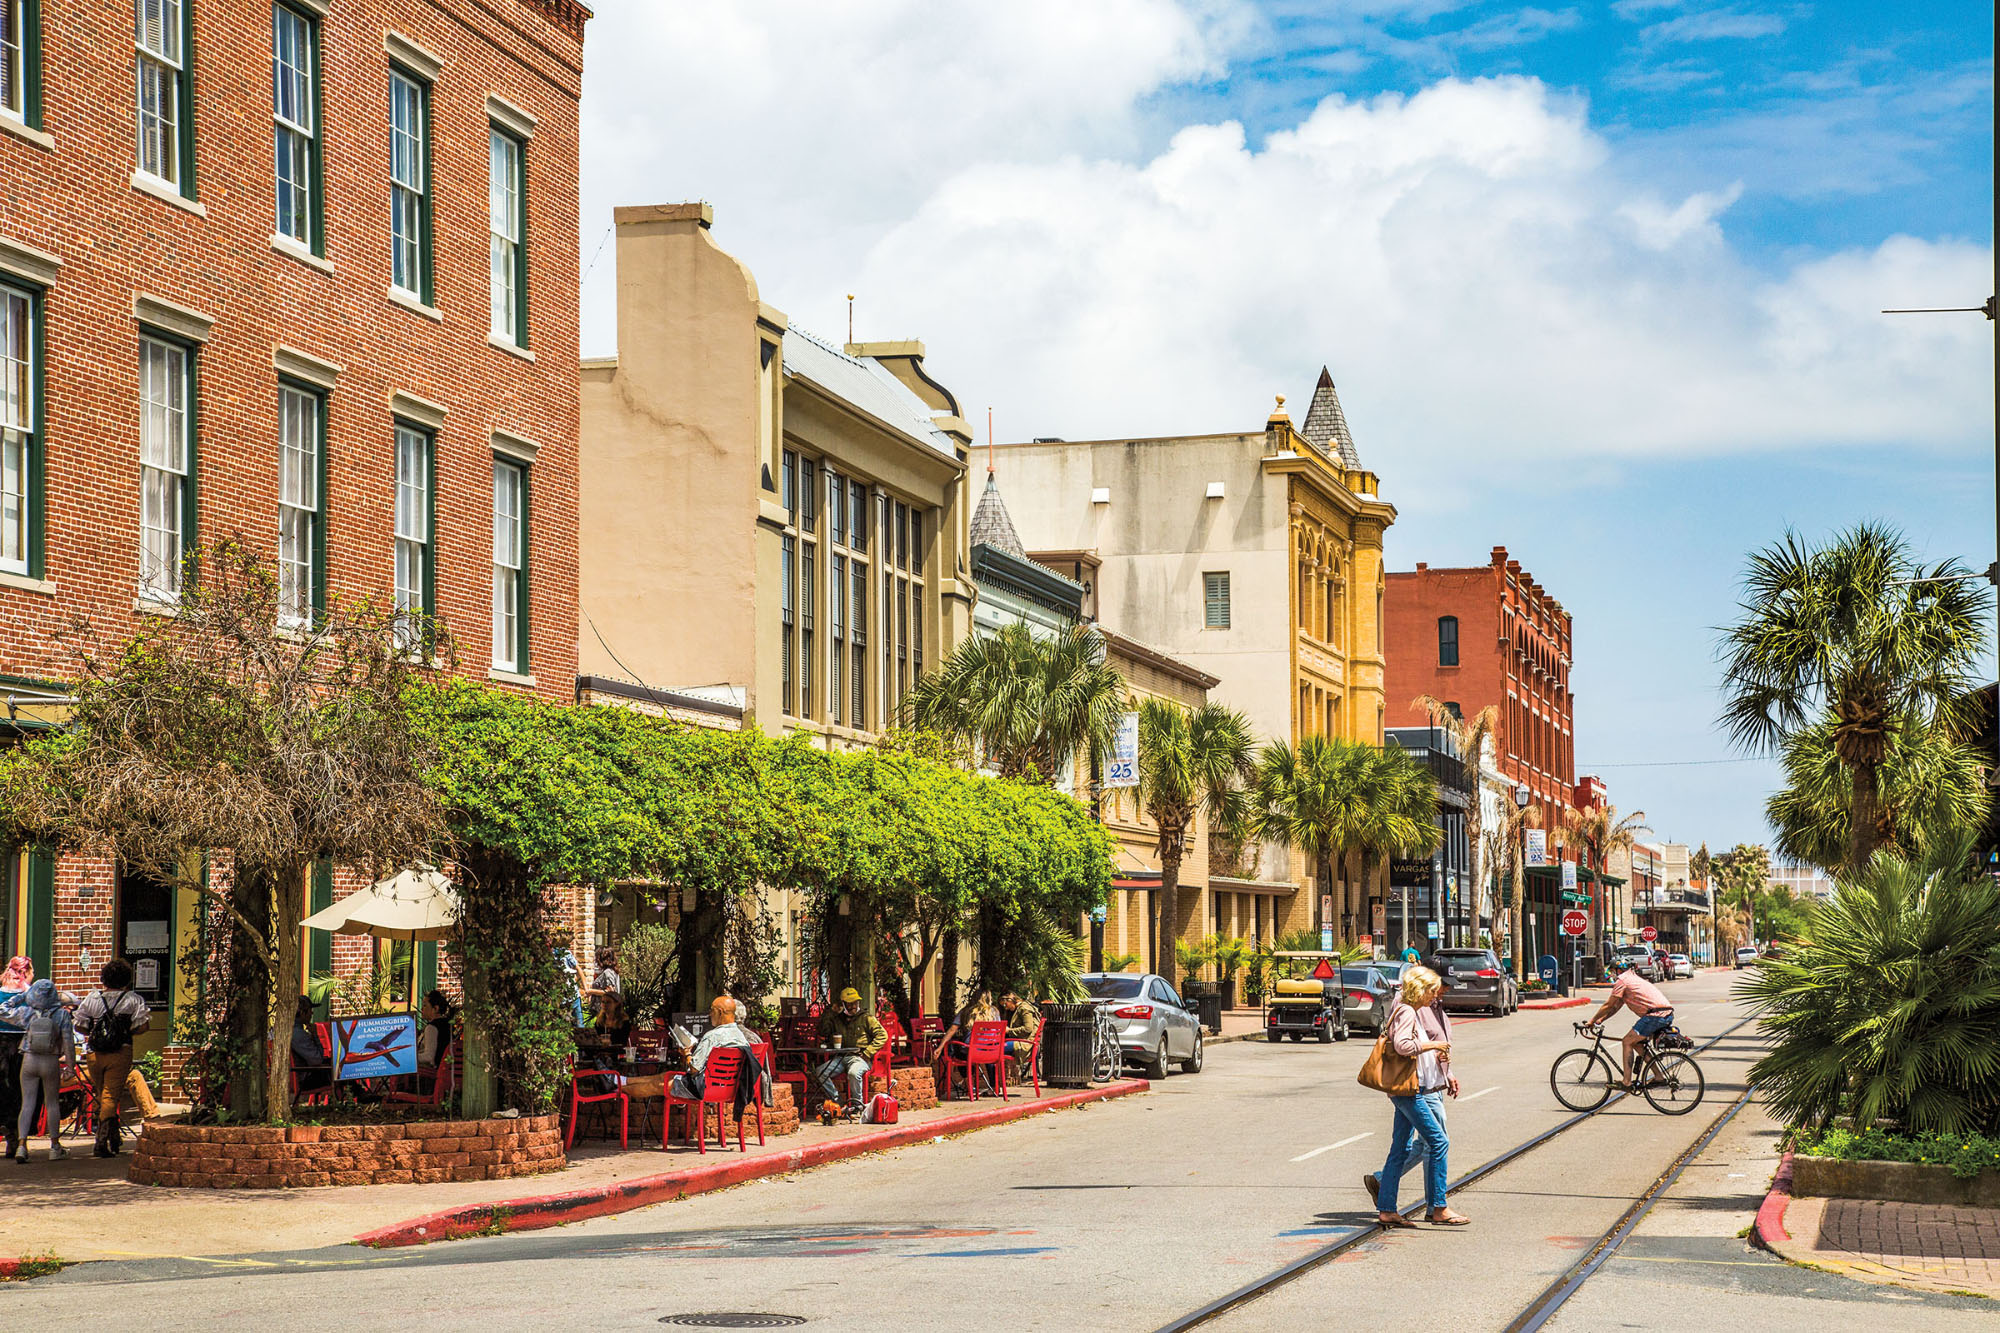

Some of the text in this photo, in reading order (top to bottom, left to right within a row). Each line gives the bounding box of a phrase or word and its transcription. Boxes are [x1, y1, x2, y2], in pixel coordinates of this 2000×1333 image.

[1110, 762, 1132, 778] 25
[1564, 918, 1586, 928] STOP
[358, 1017, 410, 1028] HUMMINGBIRD
[363, 1024, 405, 1034] LANDSCAPES
